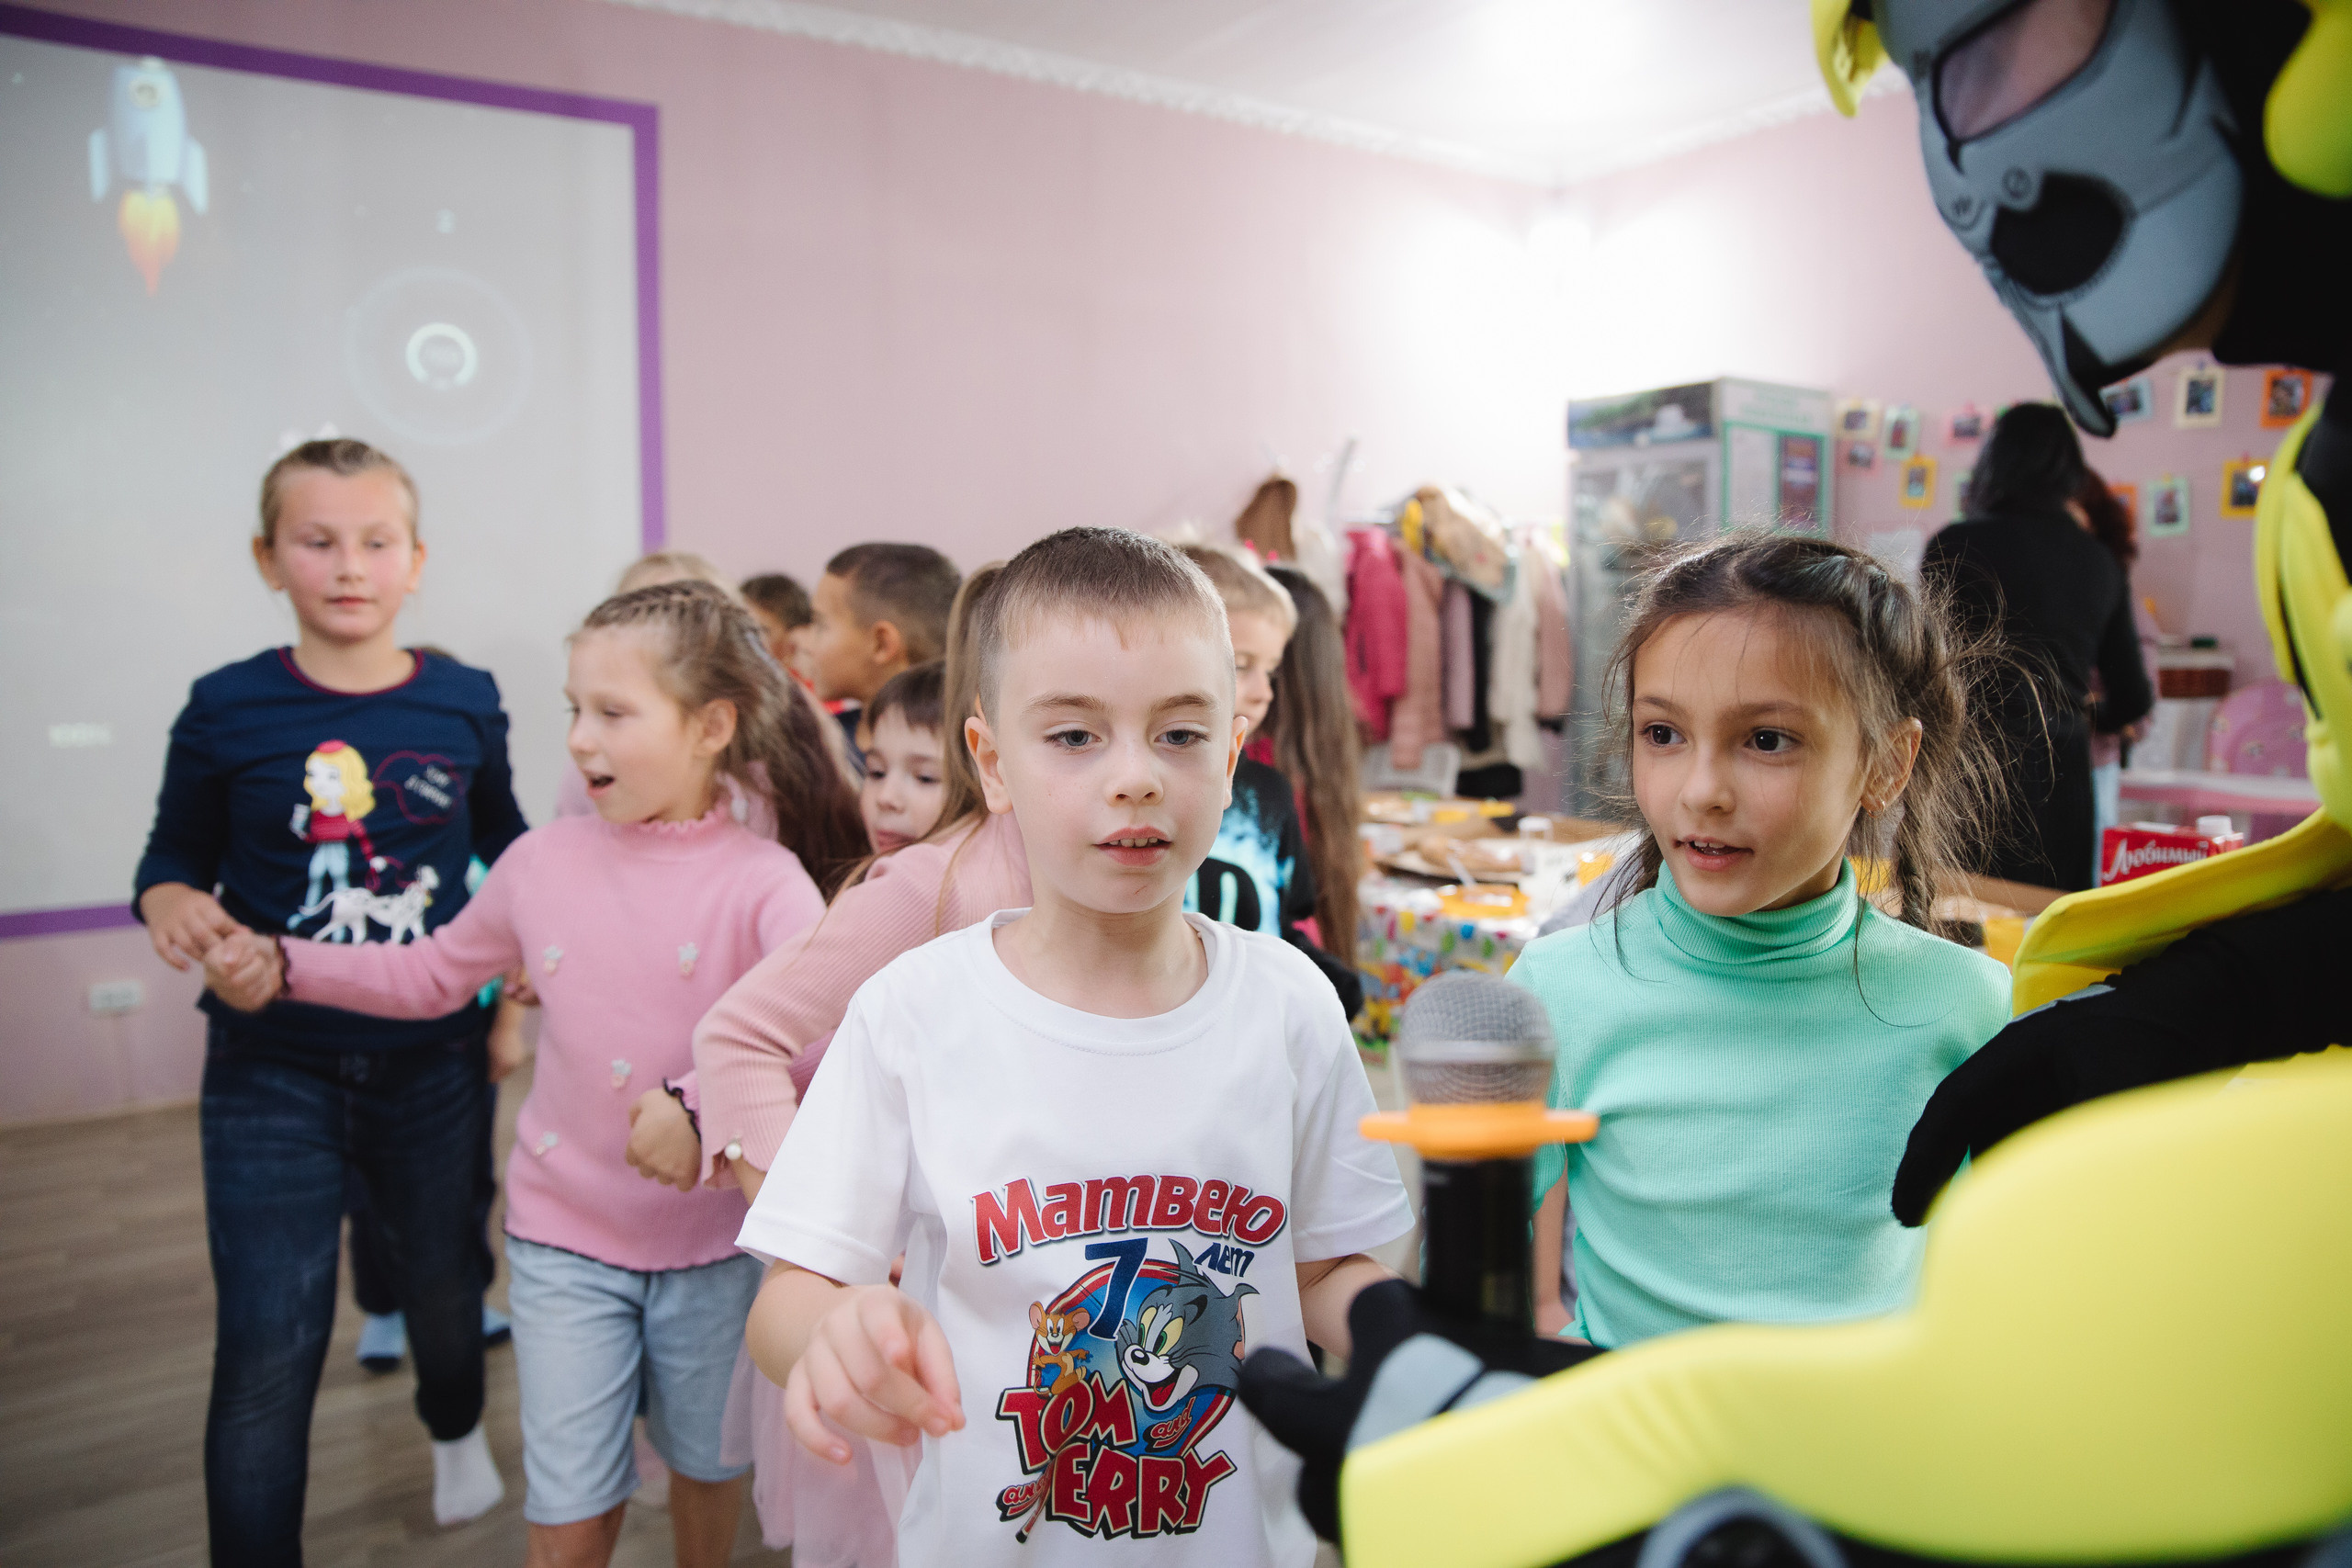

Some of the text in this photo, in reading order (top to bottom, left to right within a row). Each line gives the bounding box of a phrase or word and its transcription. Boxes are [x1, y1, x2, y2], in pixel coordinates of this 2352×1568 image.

[971, 1174, 1286, 1265] Матвею
[1083, 1237, 1148, 1340] 7
[996, 1371, 1138, 1476] TOM
[1145, 1395, 1197, 1450] and
